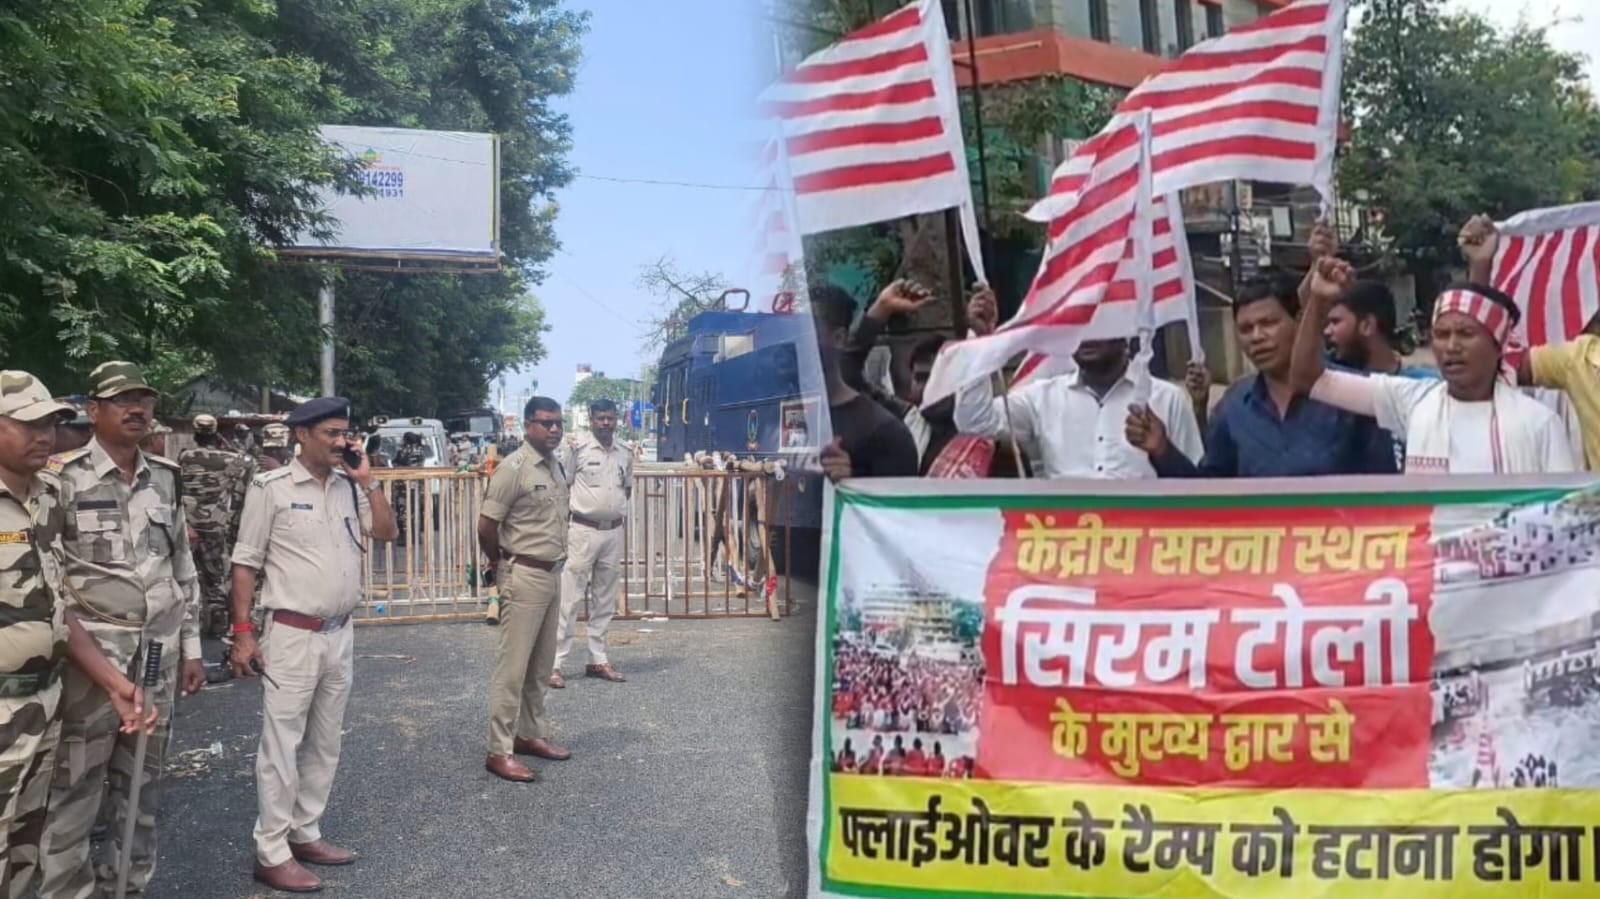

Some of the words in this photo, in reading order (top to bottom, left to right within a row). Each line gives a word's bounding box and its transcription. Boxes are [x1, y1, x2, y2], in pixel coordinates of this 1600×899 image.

[1016, 514, 1143, 578] केंद्रीय
[1149, 525, 1286, 575] सरना
[1292, 523, 1416, 574] स्थल
[994, 583, 1219, 689] सिरम
[1229, 578, 1419, 688] टोली
[1049, 697, 1092, 758] के
[1096, 712, 1213, 777] मुख्य
[1220, 712, 1299, 771] द्वार
[1305, 699, 1355, 764] से
[839, 795, 1054, 868] फ्लाईओवर
[1062, 801, 1113, 874] के
[1122, 798, 1218, 877] रैम्प
[1231, 804, 1299, 879] को
[1309, 824, 1459, 882] हटाना
